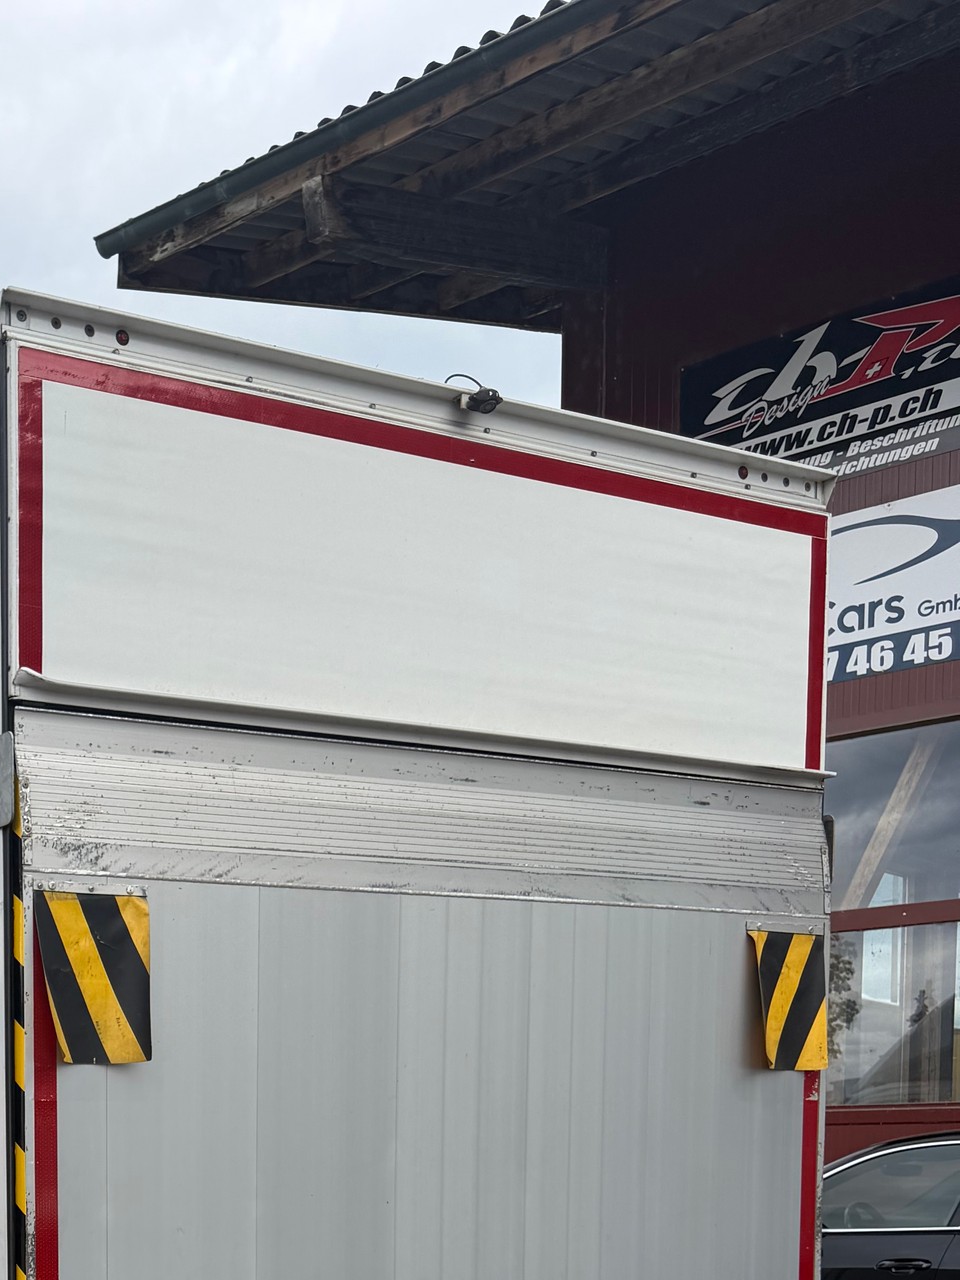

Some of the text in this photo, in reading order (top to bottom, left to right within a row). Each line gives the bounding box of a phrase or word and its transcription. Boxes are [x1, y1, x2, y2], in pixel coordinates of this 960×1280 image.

[741, 375, 832, 438] Design
[846, 640, 895, 676] 46
[902, 627, 953, 665] 45
